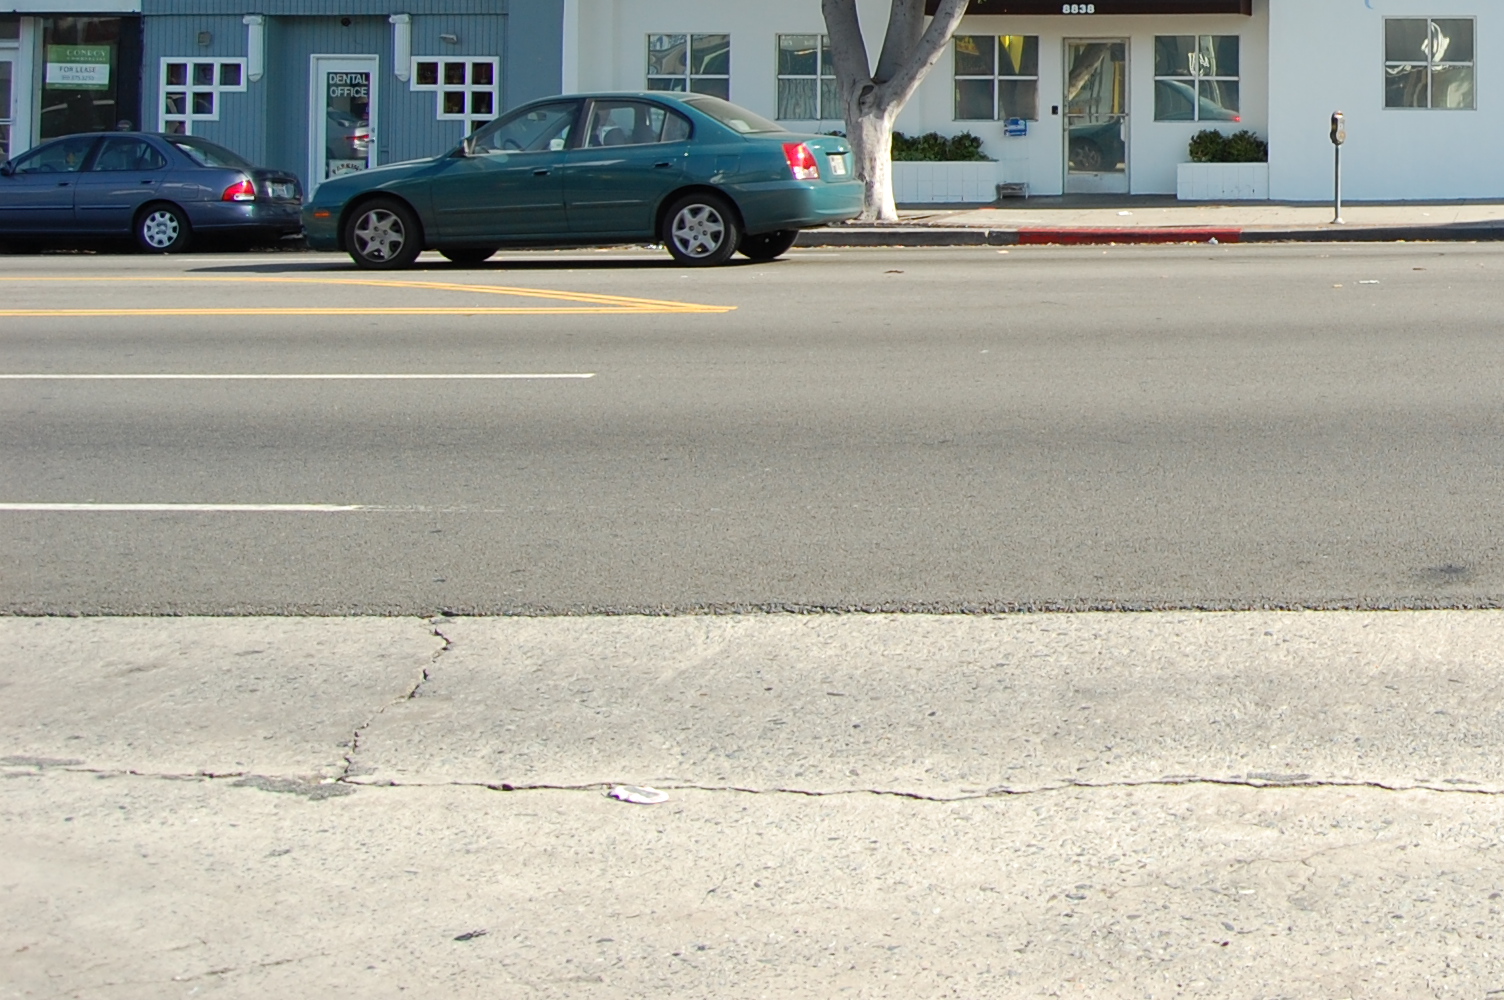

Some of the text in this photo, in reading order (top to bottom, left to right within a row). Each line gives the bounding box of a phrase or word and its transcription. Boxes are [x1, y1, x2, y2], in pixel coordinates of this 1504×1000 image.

[1062, 3, 1095, 14] 8838
[329, 73, 368, 84] DENTAL
[330, 86, 368, 97] OFFICE
